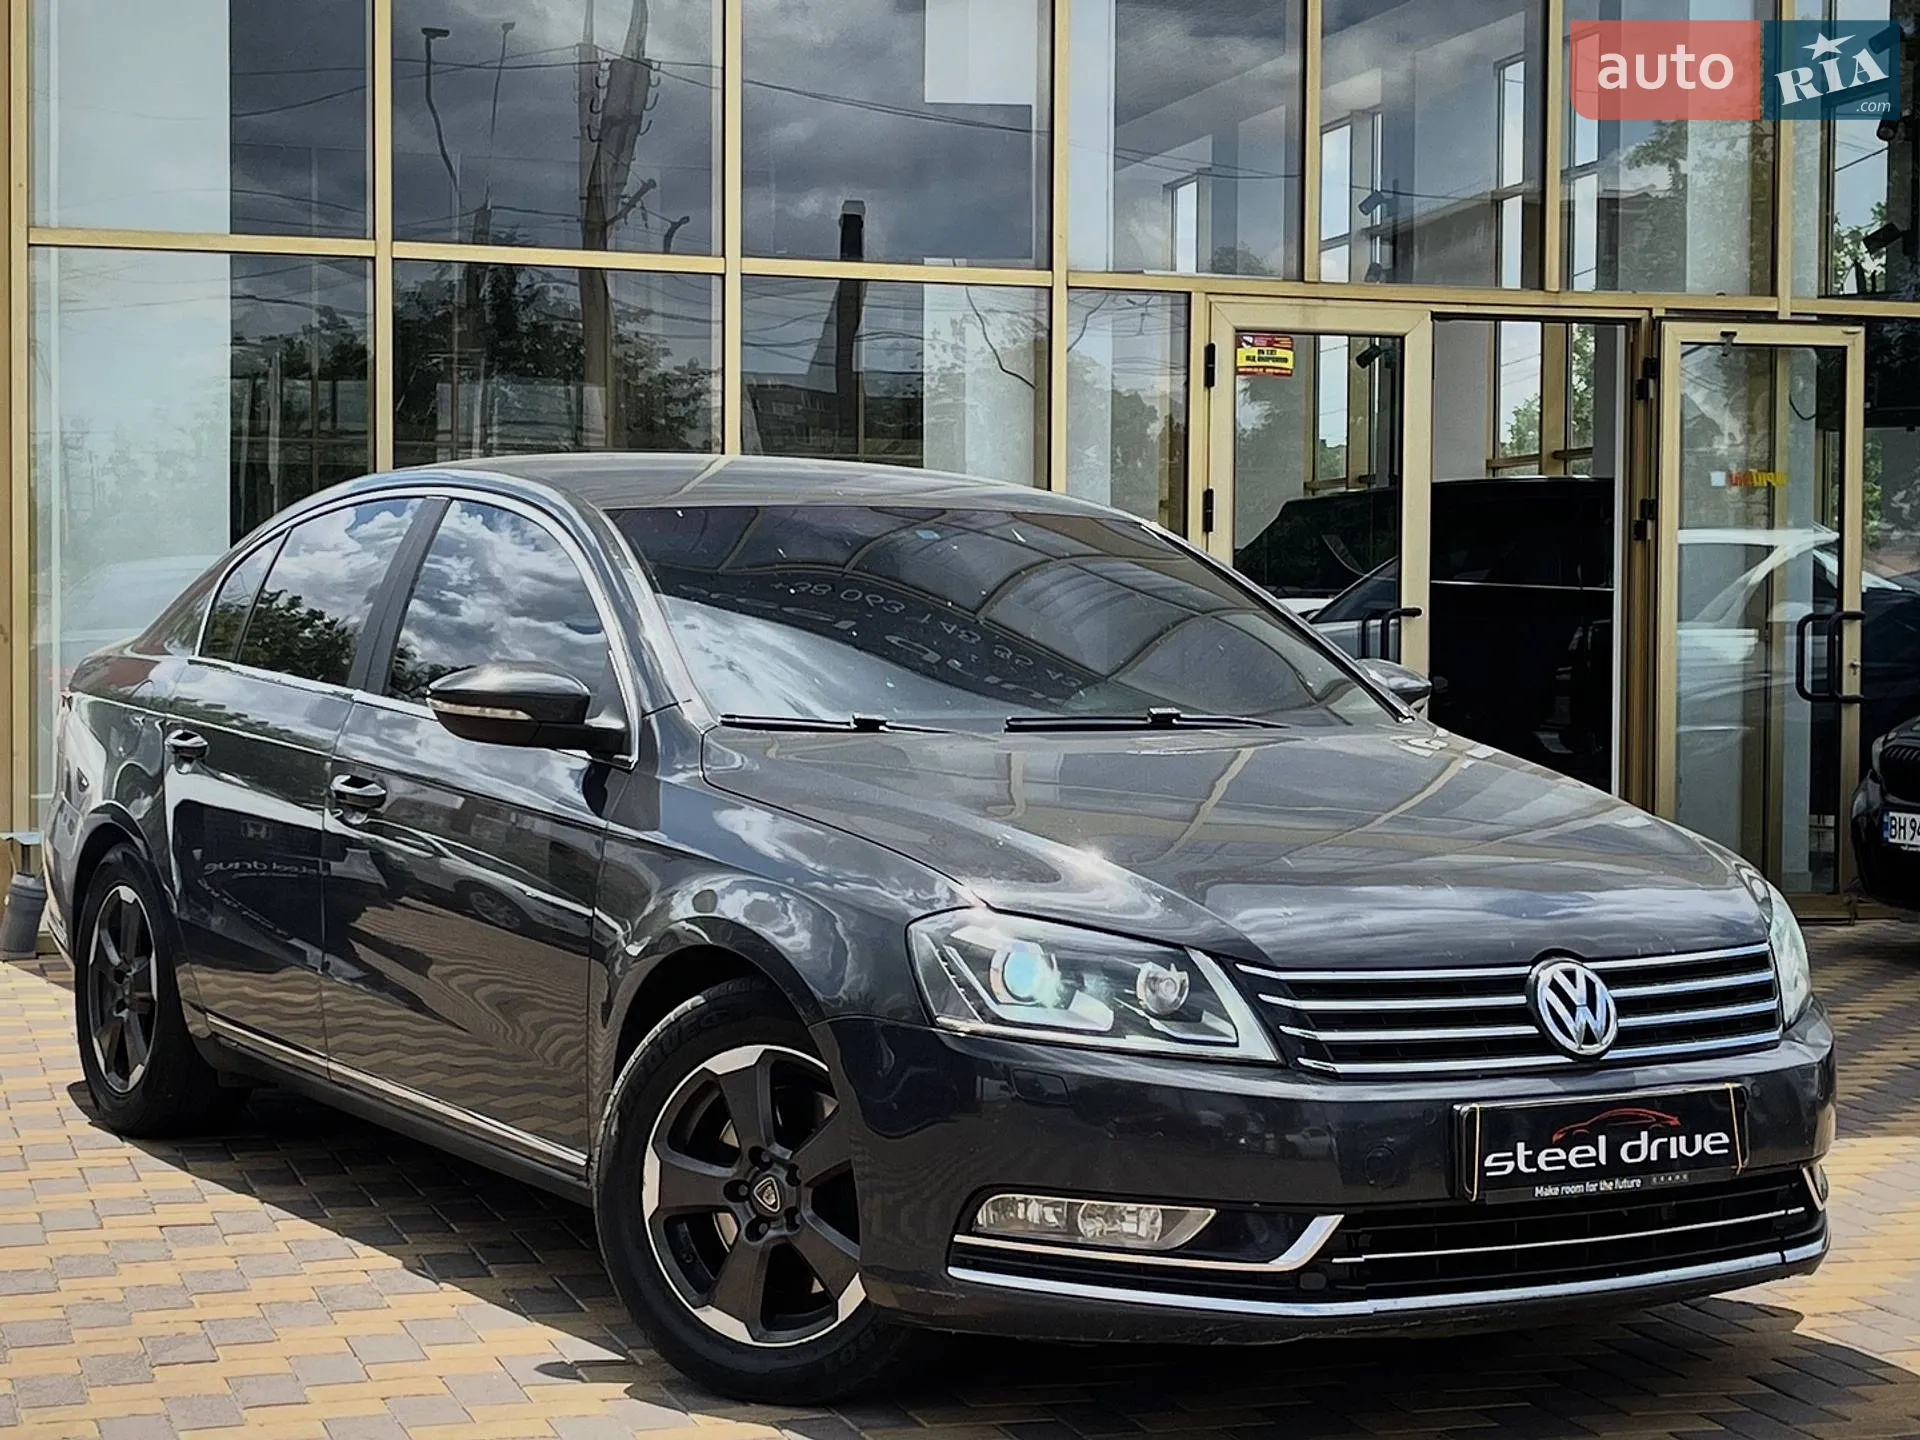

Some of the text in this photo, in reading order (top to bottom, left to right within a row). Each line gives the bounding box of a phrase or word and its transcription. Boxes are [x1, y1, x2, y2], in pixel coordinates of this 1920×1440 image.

[1889, 816, 1907, 840] BH
[1484, 1131, 1730, 1176] steel drive
[1534, 1185, 1559, 1198] Make
[1560, 1183, 1585, 1195] room
[1585, 1181, 1598, 1193] for
[1599, 1179, 1614, 1191] the
[1614, 1178, 1642, 1191] future
